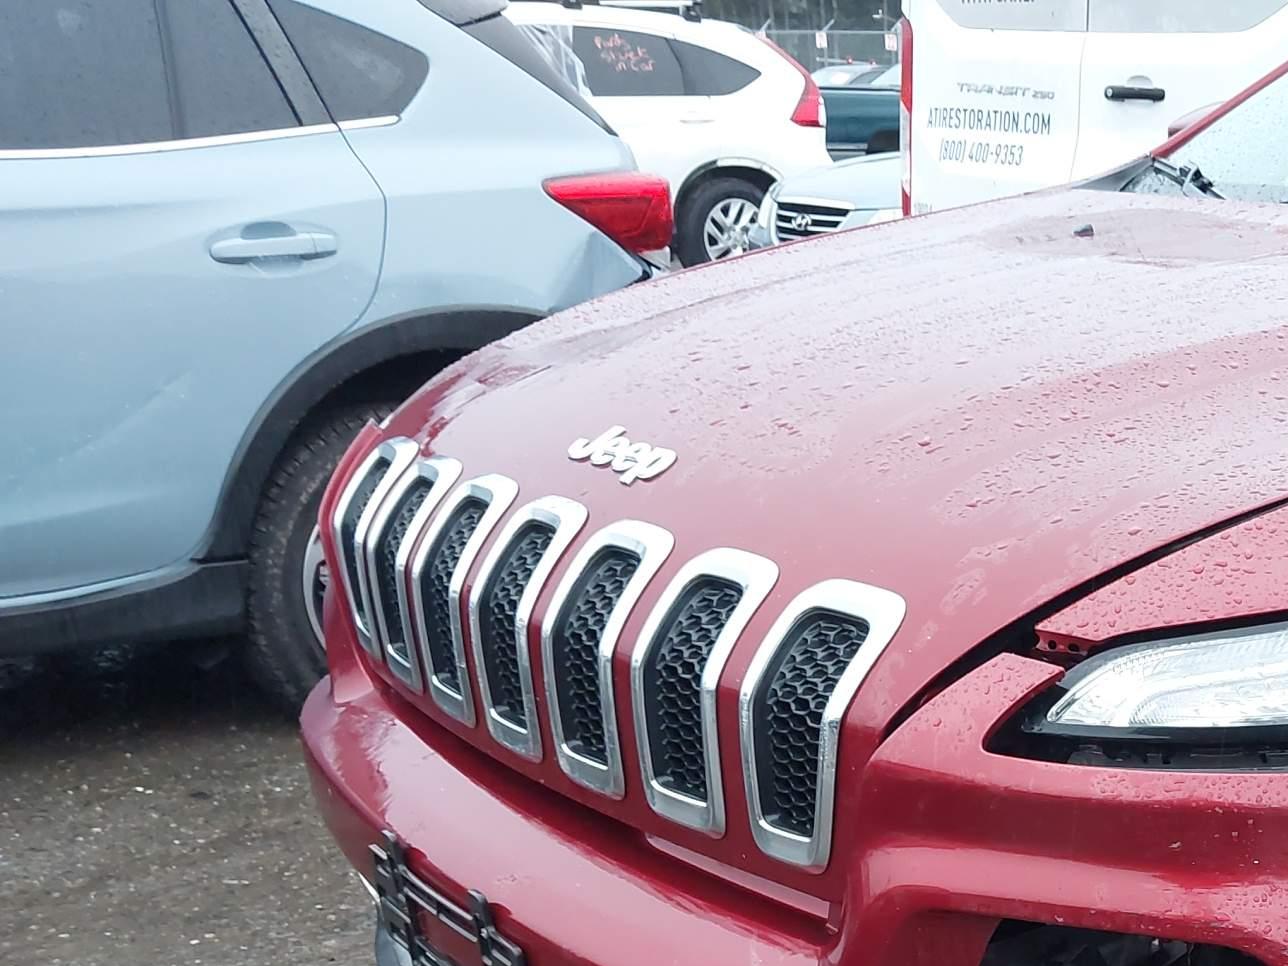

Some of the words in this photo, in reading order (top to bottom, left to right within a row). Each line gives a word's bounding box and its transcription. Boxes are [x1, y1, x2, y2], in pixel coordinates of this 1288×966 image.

[927, 107, 1051, 136] ATIRESTORATION.COM
[939, 137, 967, 163] (800)
[968, 141, 1024, 166] 400-9353
[567, 424, 678, 486] Jeep
